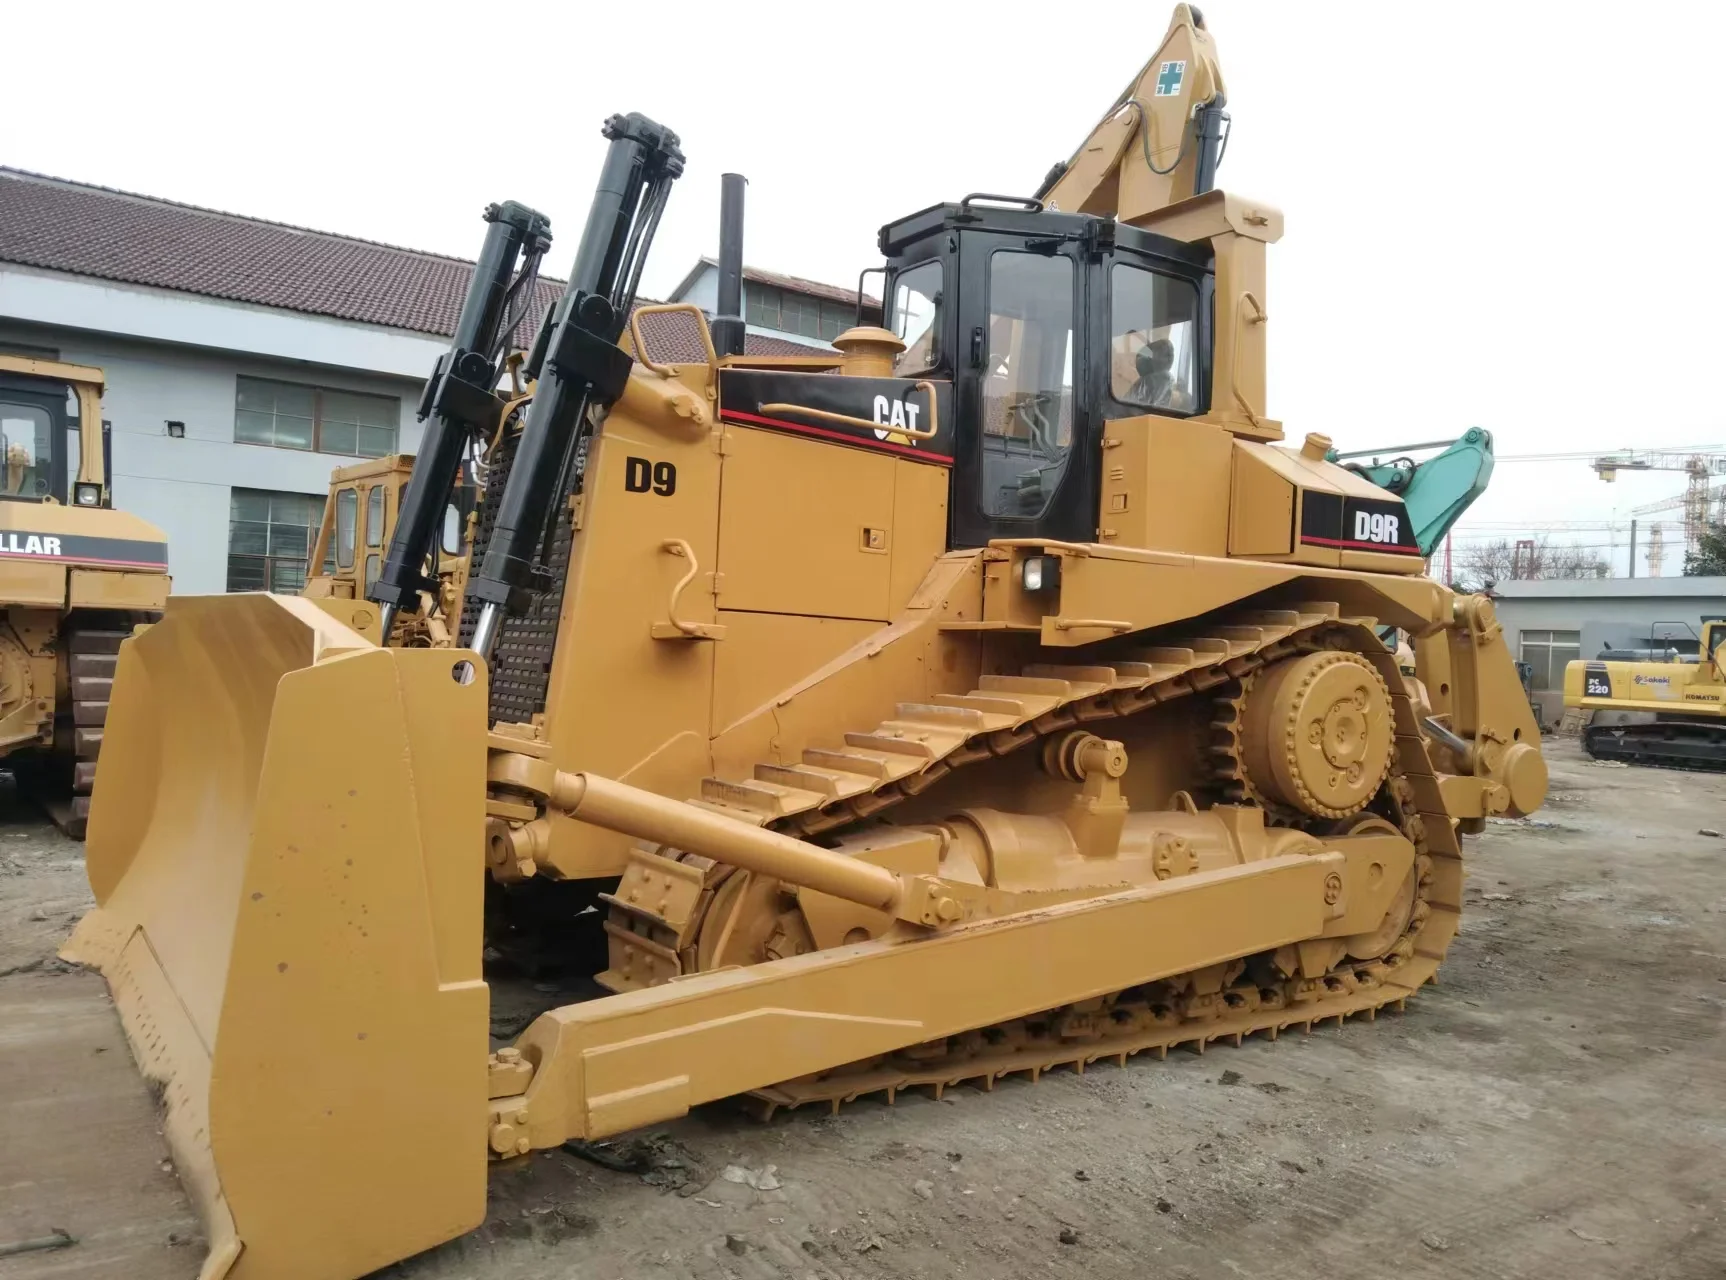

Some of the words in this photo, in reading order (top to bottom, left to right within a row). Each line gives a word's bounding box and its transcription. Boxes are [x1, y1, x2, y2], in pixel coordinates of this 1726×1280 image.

[874, 395, 919, 446] CAT
[625, 456, 676, 497] D9
[1354, 510, 1399, 544] D9R
[1588, 685, 1609, 694] 220
[1685, 693, 1720, 701] KOMATSU
